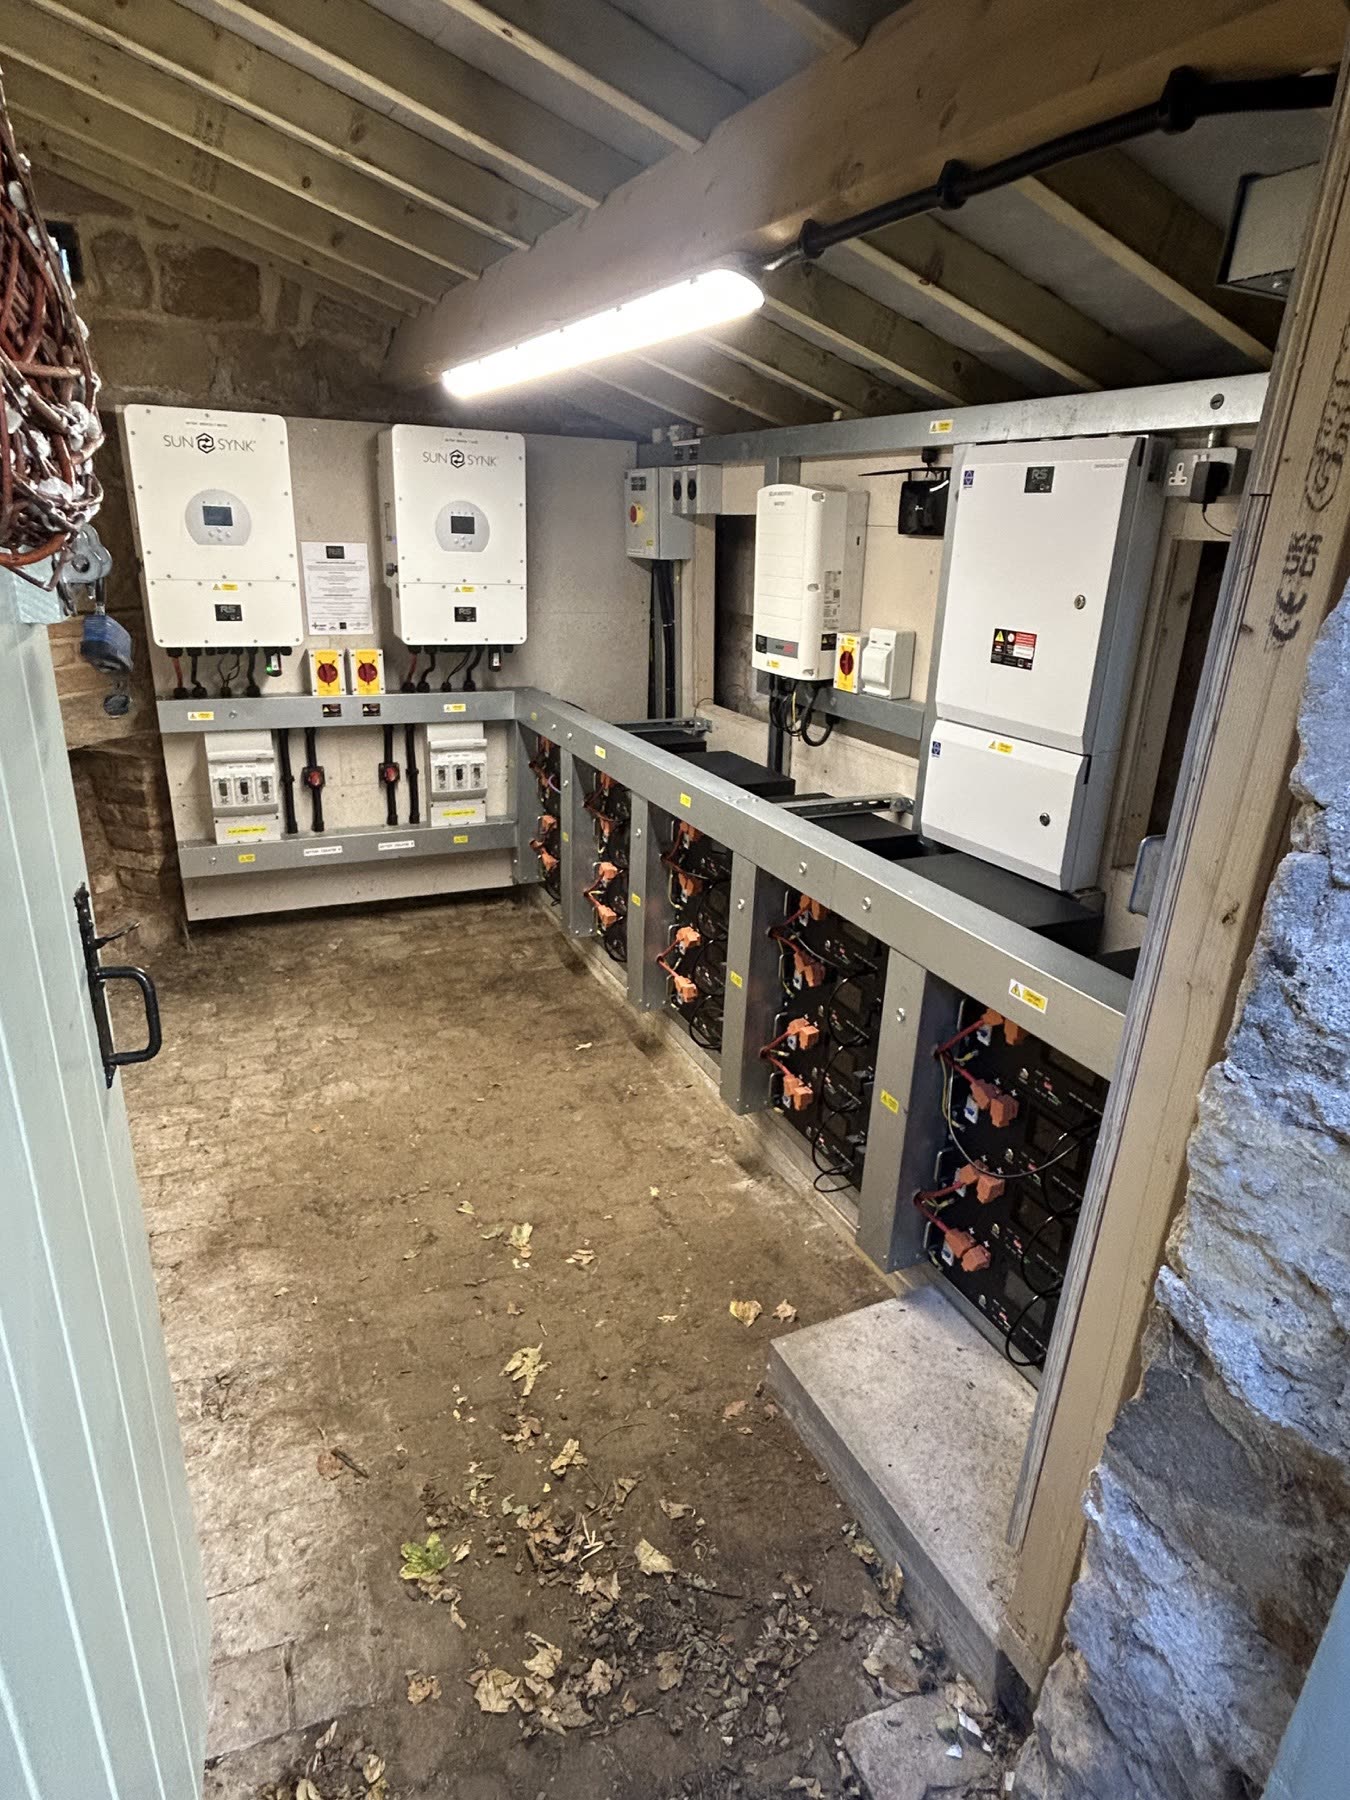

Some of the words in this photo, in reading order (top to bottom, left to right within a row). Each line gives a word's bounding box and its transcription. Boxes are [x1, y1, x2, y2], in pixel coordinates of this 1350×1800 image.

[162, 434, 194, 449] SUN
[217, 438, 256, 453] SYNK
[422, 451, 448, 464] SUN
[467, 454, 497, 467] SYNK
[1031, 468, 1049, 480] RS
[220, 605, 237, 614] RS
